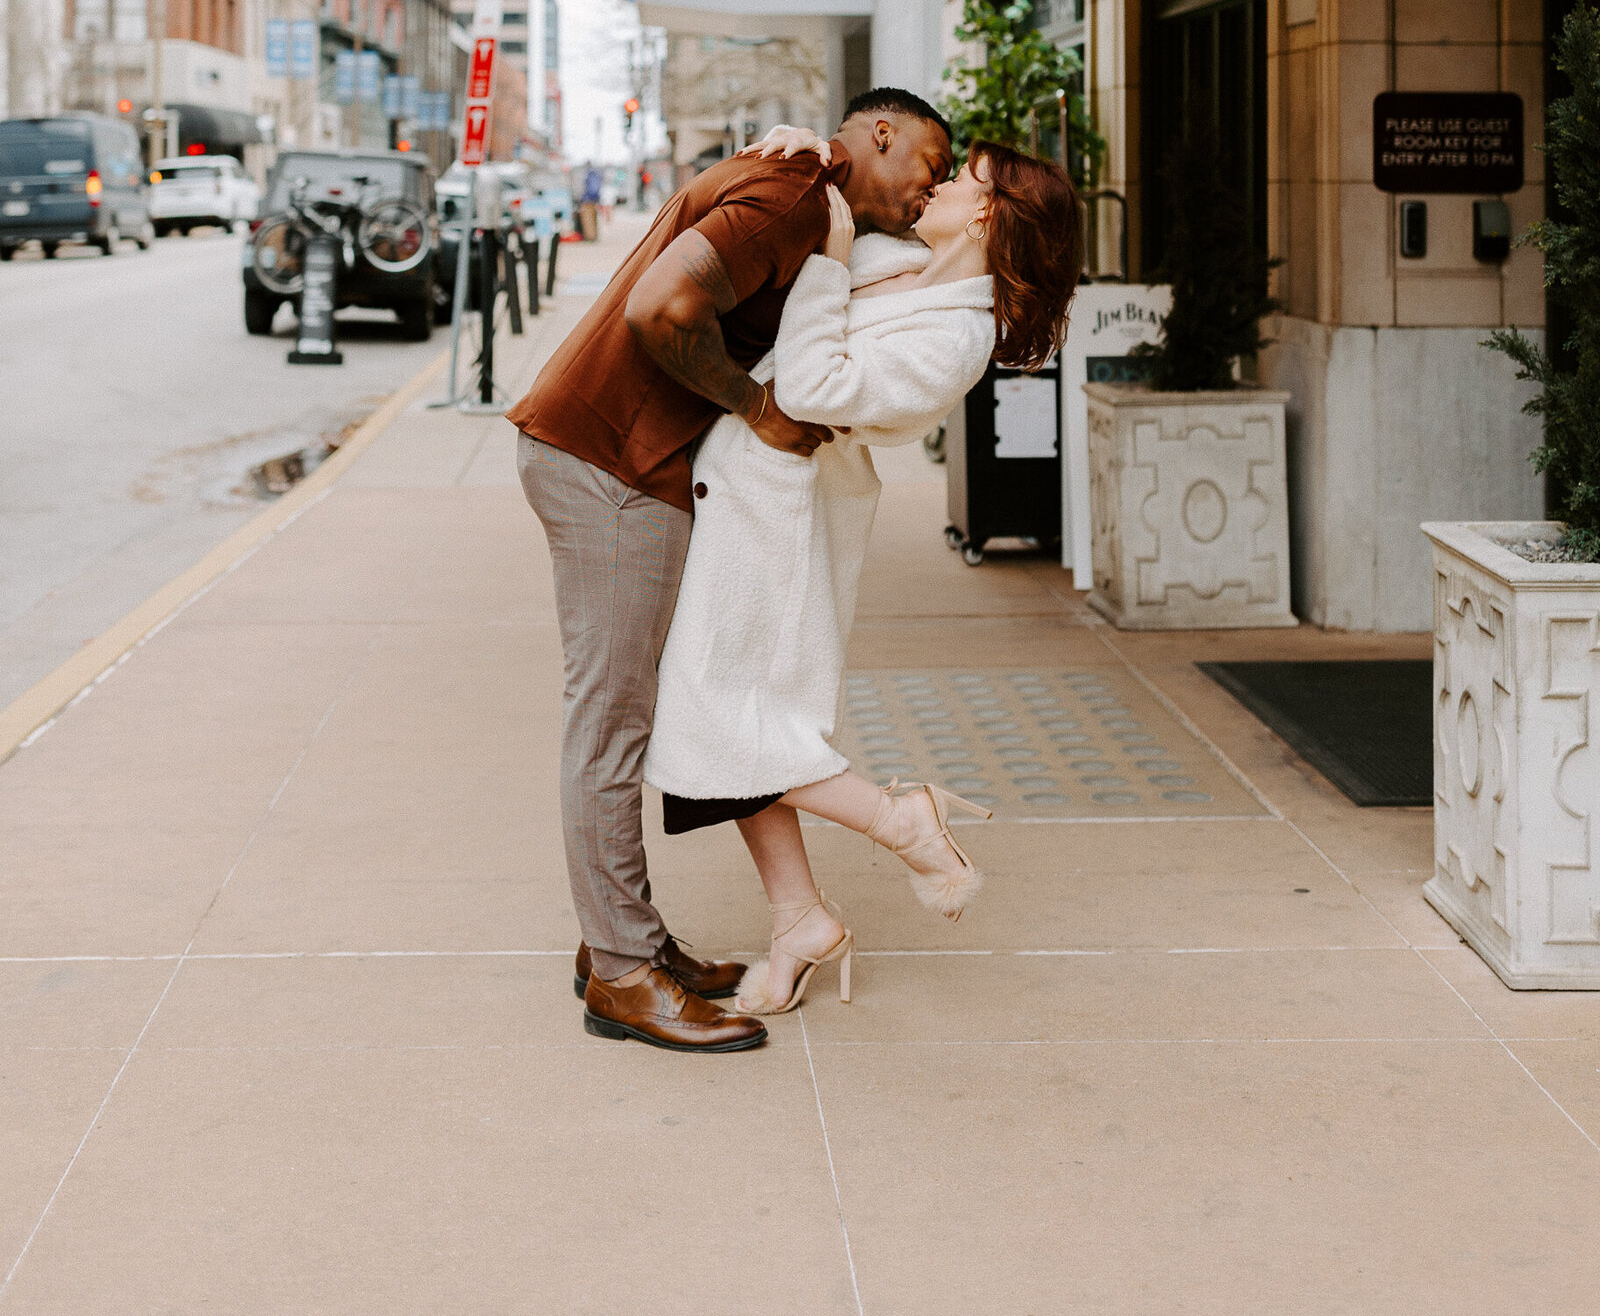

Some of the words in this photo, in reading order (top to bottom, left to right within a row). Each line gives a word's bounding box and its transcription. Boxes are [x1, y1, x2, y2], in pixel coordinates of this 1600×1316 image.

[1386, 118, 1433, 133] PLEASE
[1438, 118, 1463, 133] USE
[1466, 117, 1511, 133] GUEST
[1394, 135, 1441, 150] ROOM
[1445, 136, 1469, 149] KEY
[1473, 135, 1502, 150] FOR
[1382, 153, 1423, 167] ENTRY
[1427, 153, 1468, 167] AFTER
[1474, 153, 1489, 167] 10
[1491, 153, 1515, 166] PM
